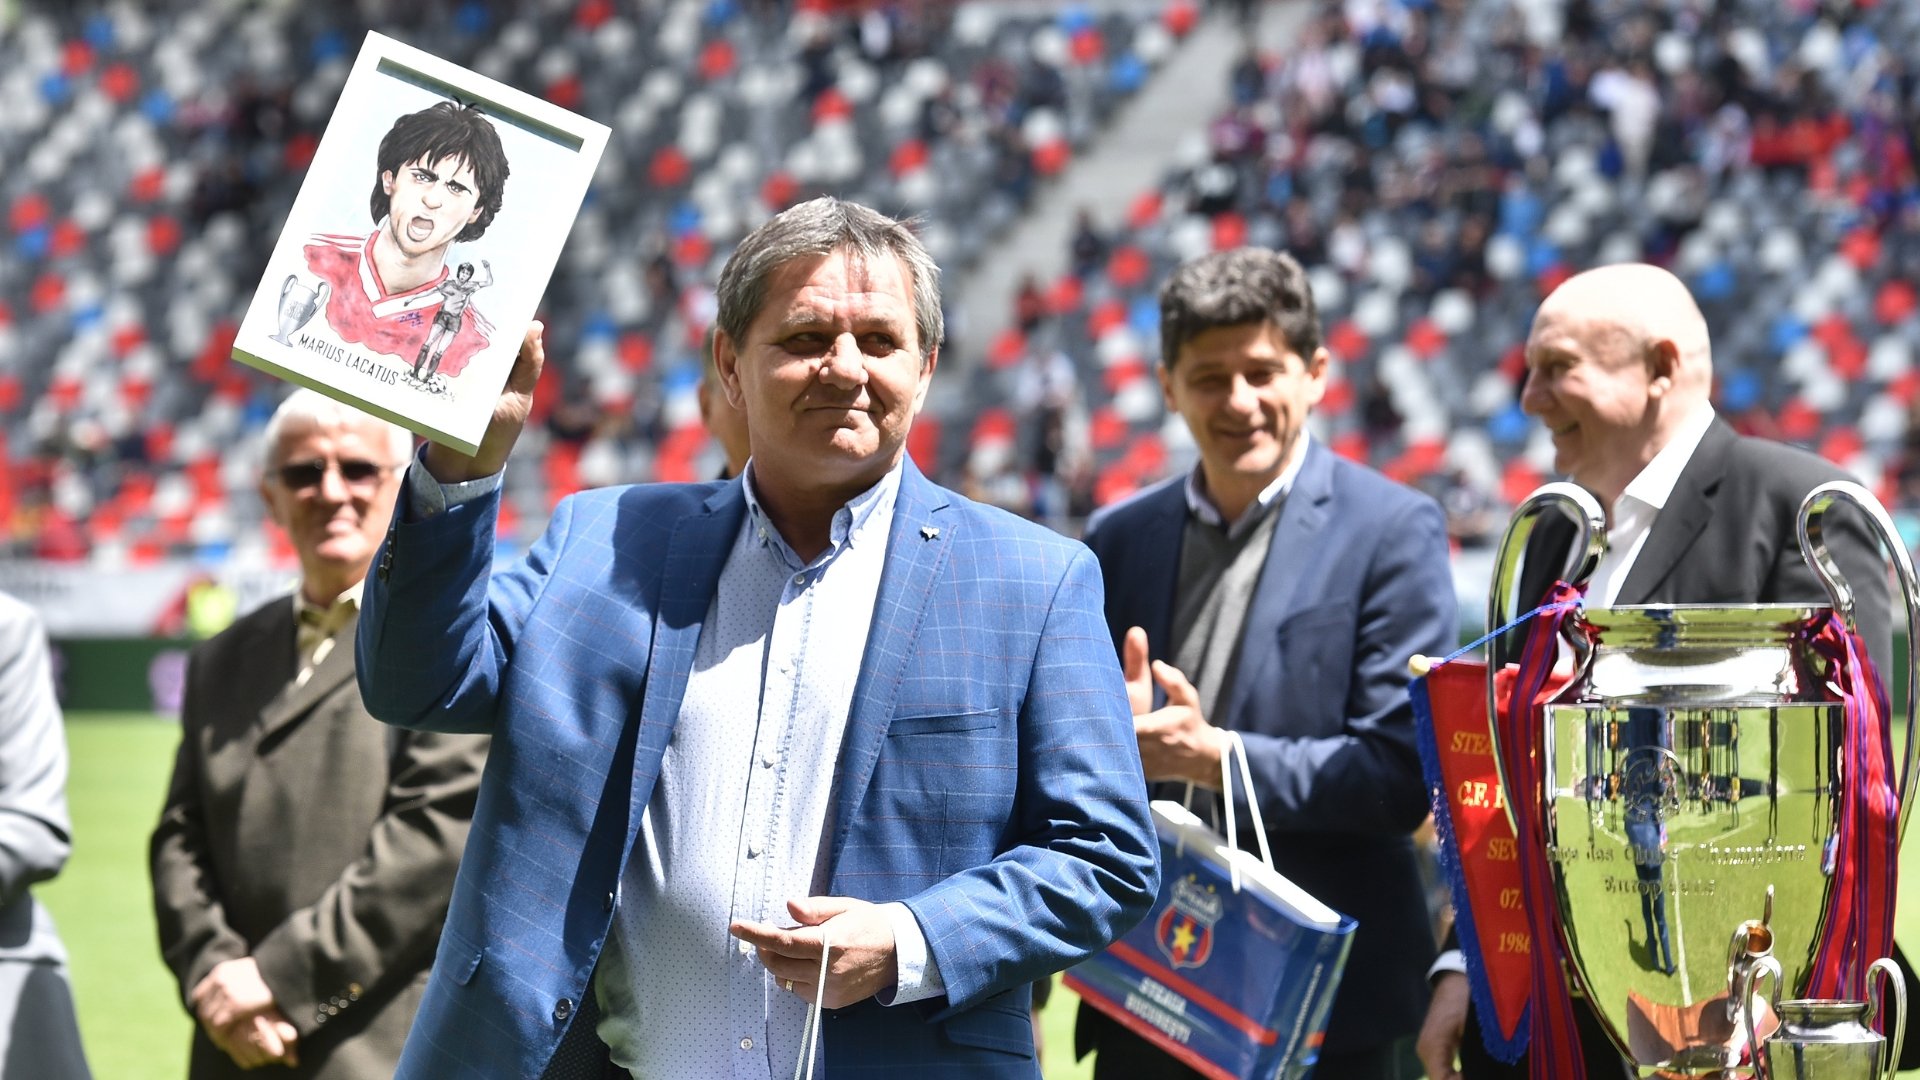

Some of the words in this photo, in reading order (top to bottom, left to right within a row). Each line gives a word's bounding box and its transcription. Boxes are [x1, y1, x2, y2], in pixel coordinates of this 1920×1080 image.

[298, 333, 344, 363] MARIUS
[345, 353, 399, 386] LACATUS
[1451, 731, 1492, 756] STEA
[1457, 780, 1489, 807] C.F.
[1487, 837, 1518, 861] SEV
[1499, 932, 1531, 954] 1986
[1139, 976, 1186, 1016] STEAUA
